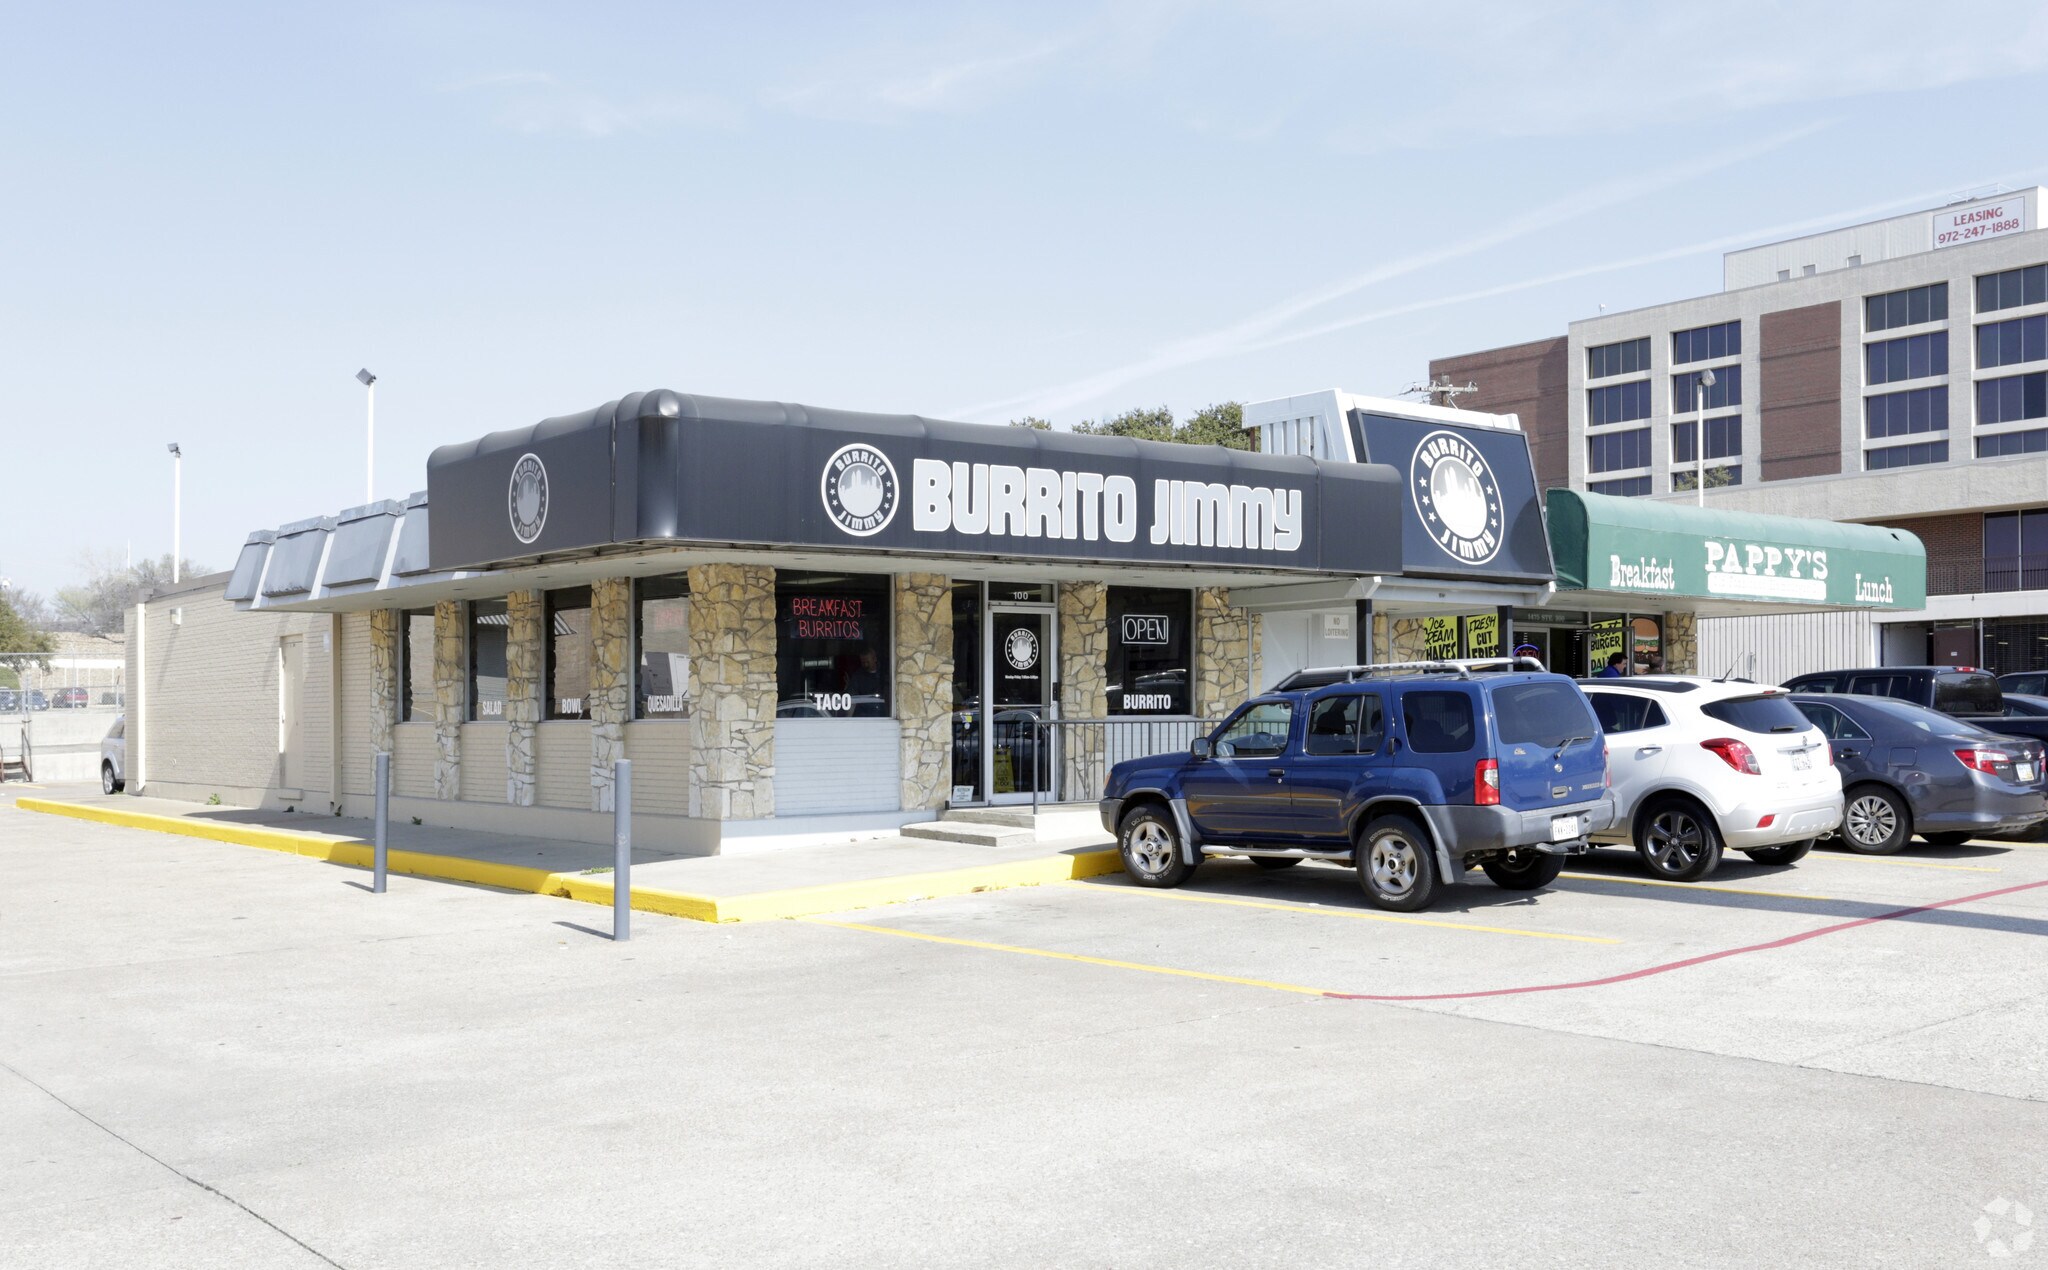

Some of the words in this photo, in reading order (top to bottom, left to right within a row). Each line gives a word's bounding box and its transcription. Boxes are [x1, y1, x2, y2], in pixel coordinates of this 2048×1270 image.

[1953, 207, 2003, 227] LEASING
[1938, 218, 2020, 244] 972-247-1888
[834, 450, 886, 476] BURRITO
[1420, 438, 1484, 477] BURRITO
[514, 460, 542, 484] BURRITO
[913, 458, 1137, 543] BURRITO
[1150, 479, 1302, 552] JIMMY
[516, 515, 541, 538] JIMMY
[837, 509, 885, 530] JIMMY
[1440, 528, 1496, 559] JIMMY
[1704, 541, 1829, 580] PAPPY'S
[1609, 554, 1675, 590] Breakfast
[1013, 591, 1029, 600] 100
[1855, 573, 1893, 603] Lunch
[792, 598, 863, 617] BREAKFAST
[799, 619, 860, 638] BURRITOS
[1125, 618, 1166, 640] OPEN
[1333, 617, 1341, 625] NO
[1428, 616, 1446, 631] Ice
[1468, 615, 1497, 634] FRESH
[1010, 630, 1034, 641] BURRITO
[1325, 628, 1349, 637] LOITERING
[1476, 630, 1493, 646] CUT
[1426, 641, 1457, 660] HAKES
[1591, 635, 1621, 651] BURGER
[482, 701, 502, 715] SALAD
[561, 698, 582, 714] BOWL
[647, 695, 684, 713] QUESADILLA
[814, 693, 852, 711] TACO
[1123, 694, 1171, 709] BURRITO
